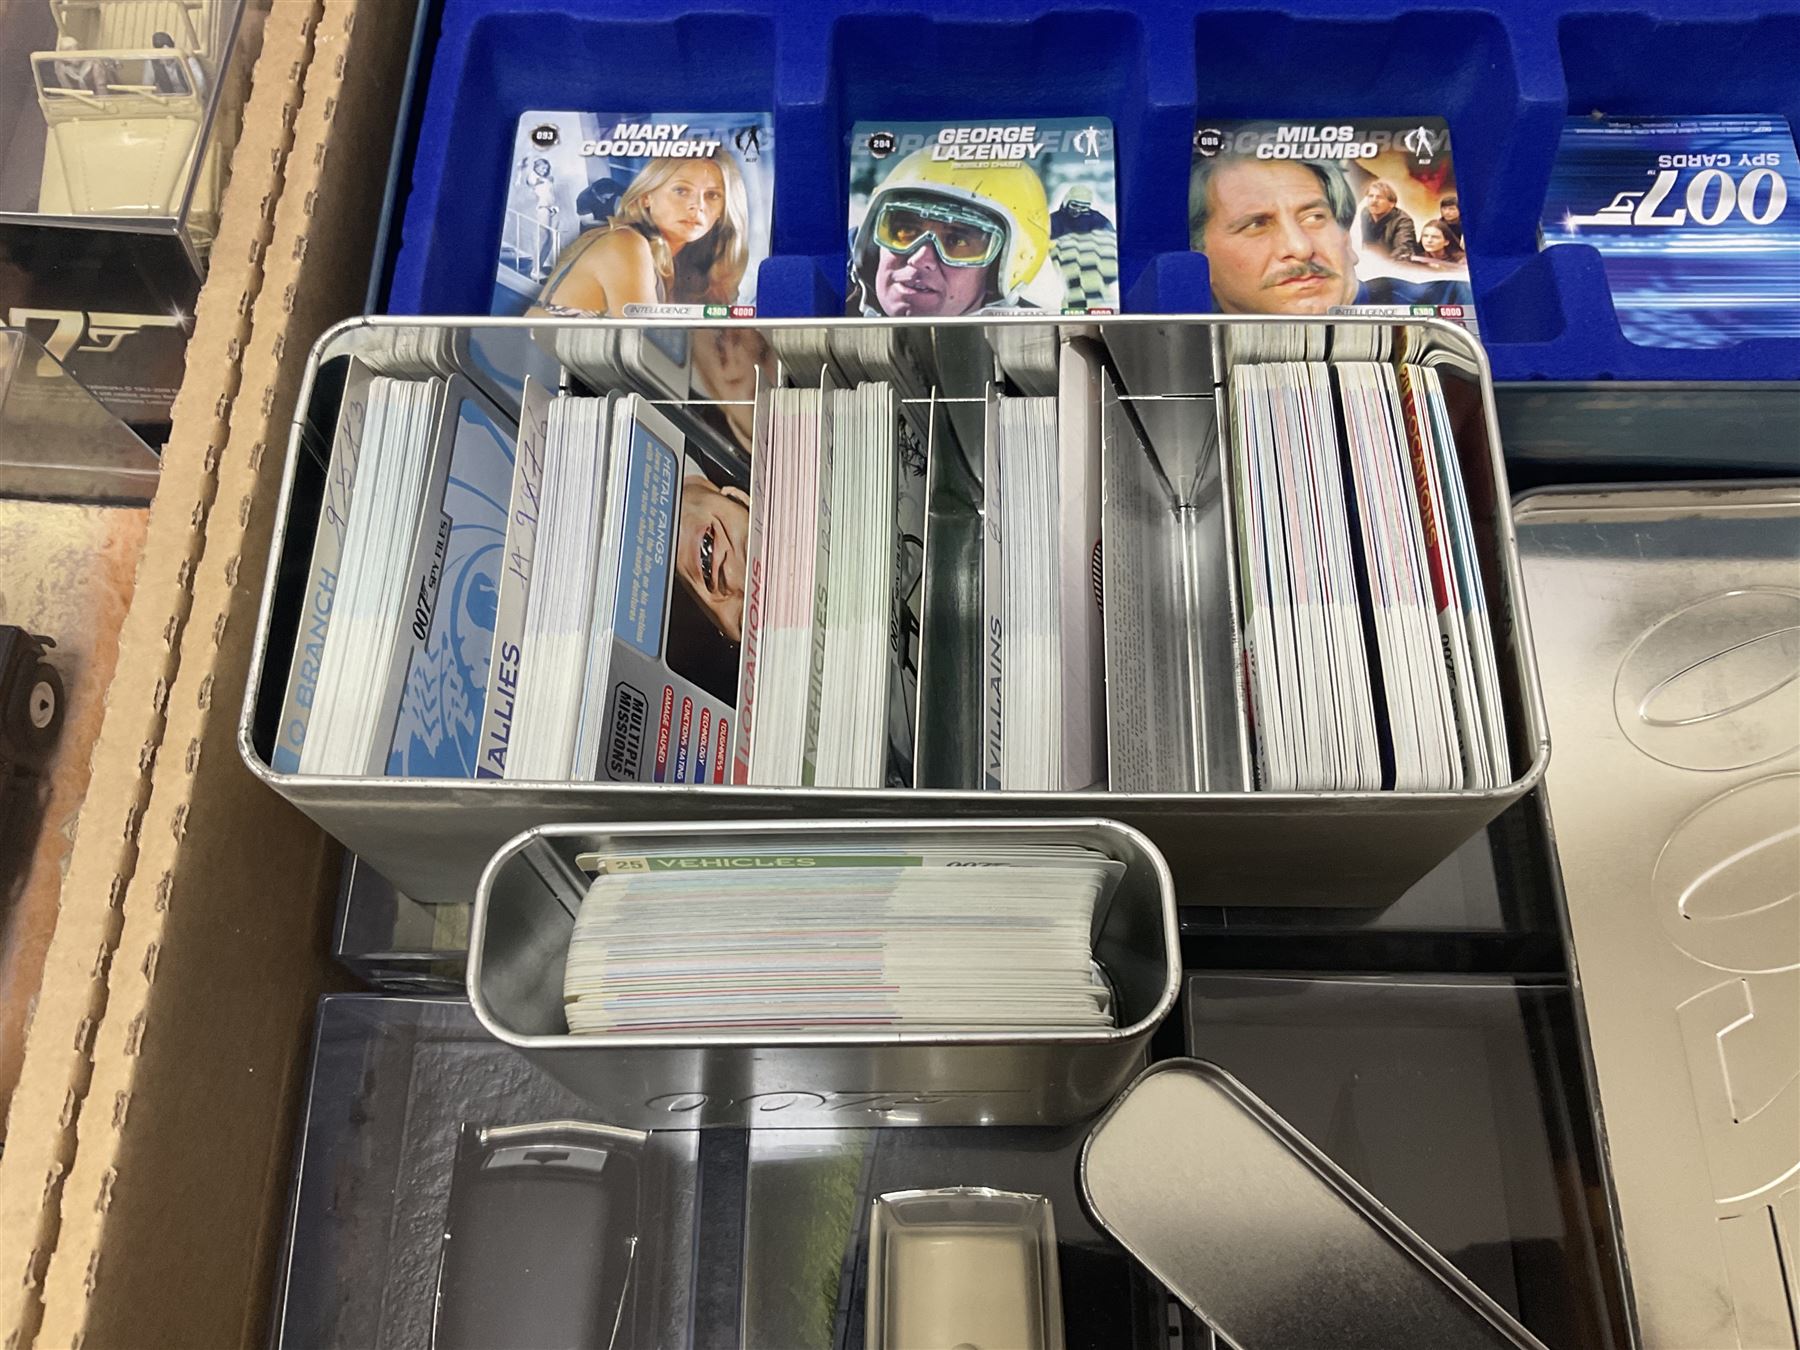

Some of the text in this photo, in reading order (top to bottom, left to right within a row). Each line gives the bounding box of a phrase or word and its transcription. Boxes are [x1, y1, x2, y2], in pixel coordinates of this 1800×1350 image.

[577, 141, 720, 158] GOODNIGHT
[613, 123, 688, 140] MARY
[931, 143, 1043, 161] LAZENBY
[937, 126, 1036, 144] GEORGE
[1256, 142, 1379, 160] COLUMBO
[1276, 126, 1354, 143] MILOS
[1658, 153, 1780, 168] SPY CARDS
[1634, 168, 1788, 226] 007
[629, 306, 691, 315] INTELLIGENCE
[1335, 307, 1398, 316] INTELLIGENCE
[1405, 399, 1438, 548] LOCATIONS
[655, 455, 672, 566] METAL FANGS
[412, 520, 448, 641] 007 SPY FILES
[296, 566, 338, 710] BRANCH
[742, 557, 762, 757] LOCATIONS
[808, 585, 829, 756] VEHICLES
[990, 617, 1002, 772] VILLAINS
[487, 640, 520, 772] ALLIES
[611, 690, 632, 774] MISSIONS
[658, 688, 672, 763] DAMAGE CAUSED
[623, 698, 644, 780] MULTIPLE
[677, 700, 692, 780] FUNCTIONS RATING
[699, 711, 710, 765] TECHNOLOGY
[717, 721, 727, 771] TOUGHNESS
[616, 860, 643, 869] 25
[657, 857, 816, 868] VEHICLES
